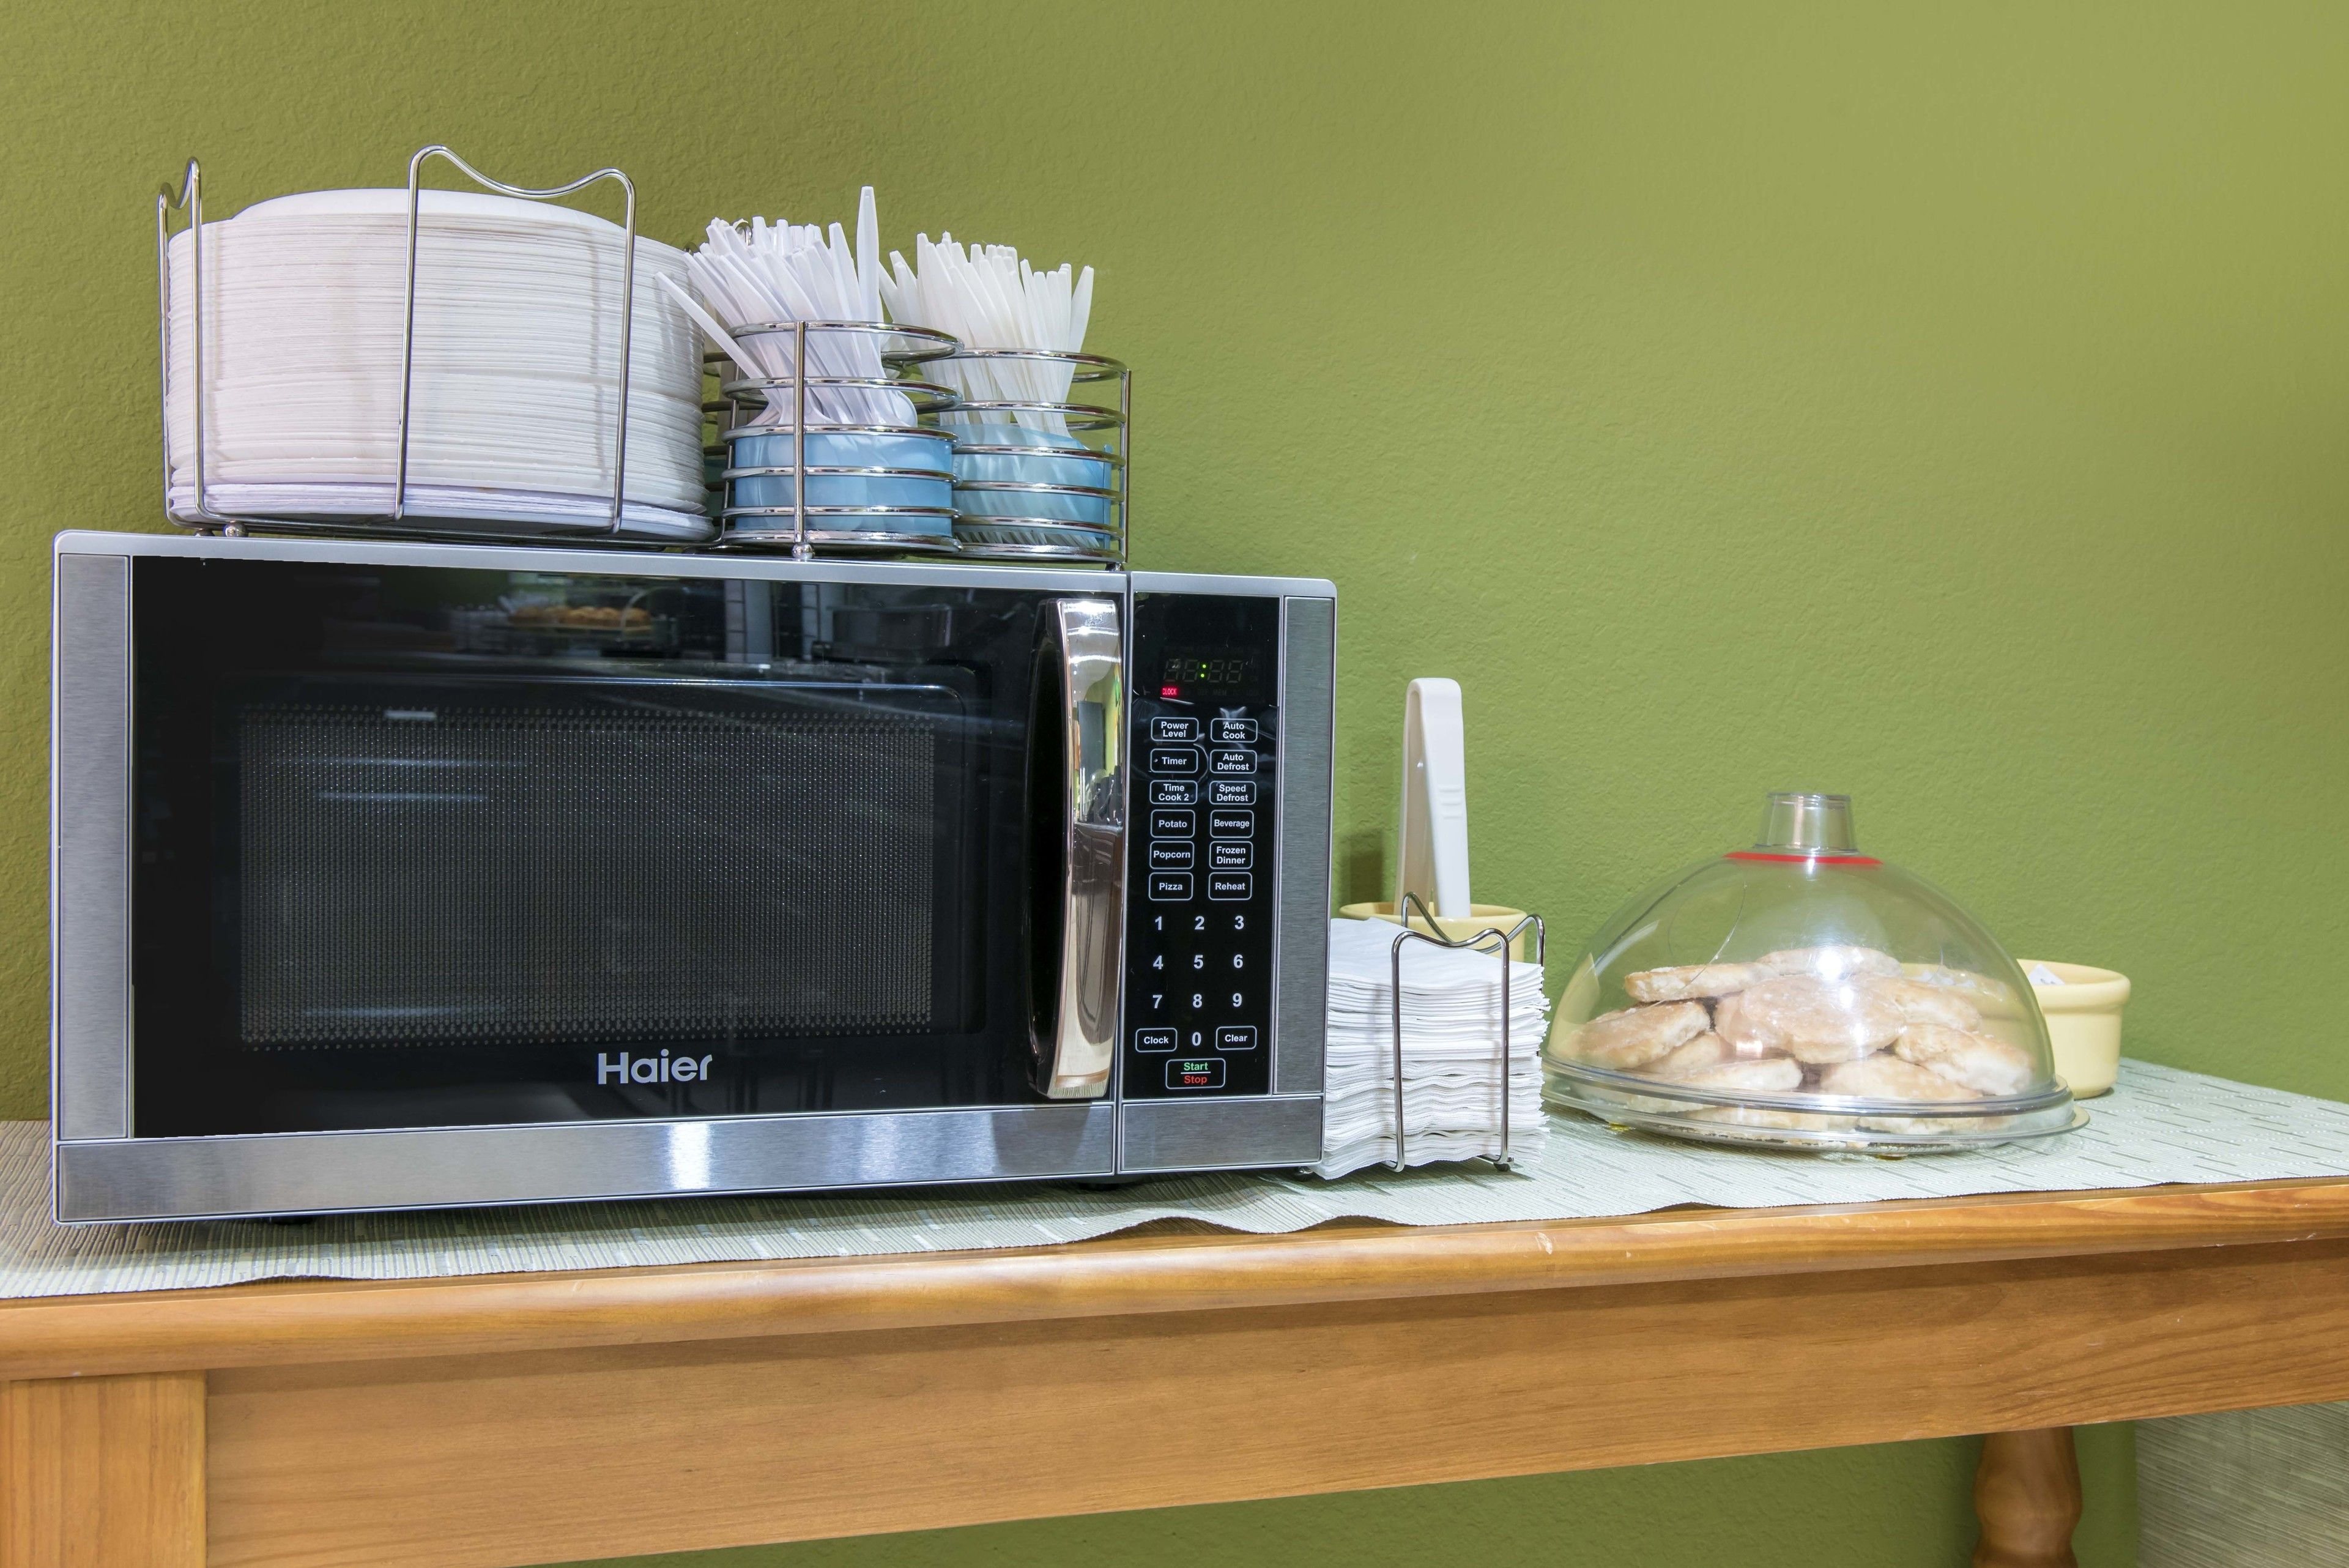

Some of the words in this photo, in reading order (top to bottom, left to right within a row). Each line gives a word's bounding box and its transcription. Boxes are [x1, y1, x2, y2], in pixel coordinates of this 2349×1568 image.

[1160, 721, 1189, 730] Power
[1223, 721, 1245, 730] Auto
[1162, 729, 1186, 738] Level
[1222, 730, 1245, 740] Cook
[1161, 756, 1187, 765] Timer
[1222, 752, 1244, 761] Auto
[1217, 762, 1250, 771] Defrost
[1163, 783, 1185, 792] Time
[1218, 784, 1247, 793] Speed
[1158, 792, 1182, 801] Cook
[1183, 793, 1189, 801] 2
[1216, 793, 1249, 802] Defrost
[1158, 819, 1187, 828] Potato
[1214, 819, 1250, 829] Beverage
[1216, 845, 1246, 854] Frozen
[1153, 850, 1191, 860] Popcorn
[1216, 856, 1246, 864] Dinner
[1159, 882, 1183, 891] Pizza
[1215, 882, 1245, 891] Reheat
[1154, 916, 1162, 931] 1
[1194, 915, 1205, 931] 2
[1234, 915, 1244, 930] 3
[1152, 955, 1163, 970] 4
[1193, 954, 1204, 970] 5
[1233, 954, 1244, 968] 6
[1152, 994, 1163, 1009] 7
[1192, 994, 1203, 1008] 8
[1232, 992, 1242, 1008] 9
[1143, 1036, 1169, 1044] Clock
[1192, 1031, 1202, 1047] 0
[1224, 1034, 1248, 1042] Clear
[598, 1049, 713, 1085] Haier
[1184, 1062, 1208, 1071] Start
[1184, 1075, 1208, 1085] Stop
